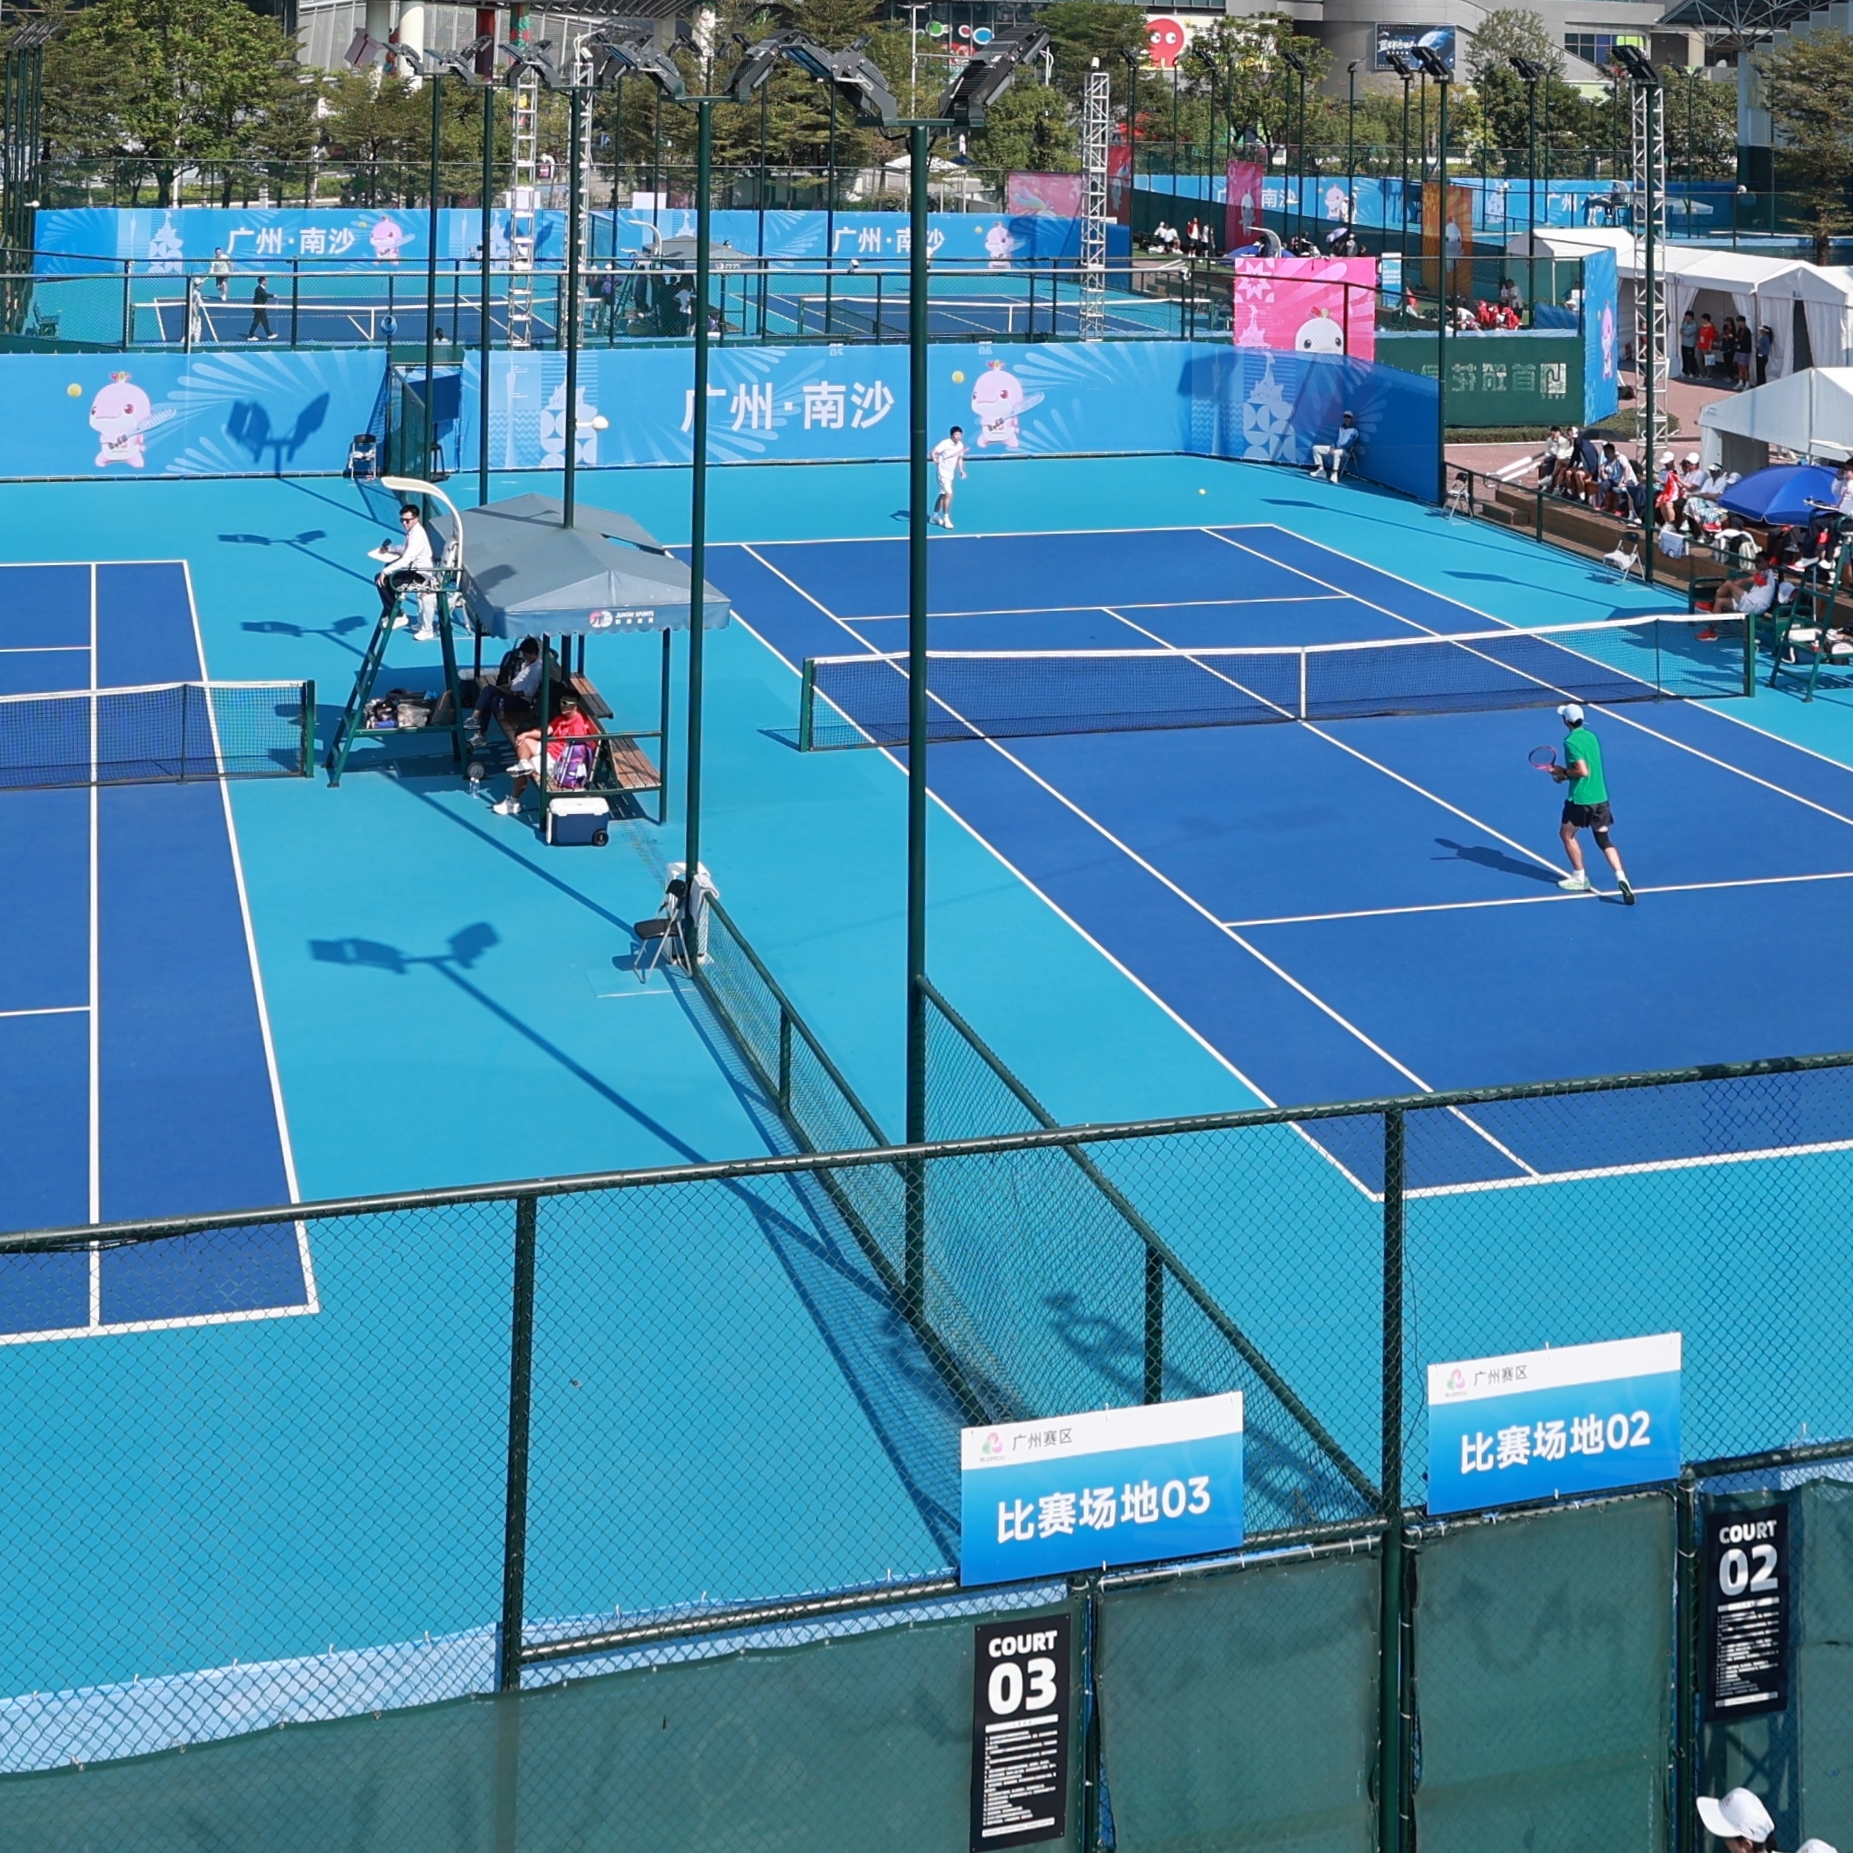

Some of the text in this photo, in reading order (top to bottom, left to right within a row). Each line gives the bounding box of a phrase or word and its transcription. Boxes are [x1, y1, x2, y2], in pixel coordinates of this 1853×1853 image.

[227, 226, 355, 255] 广州·南沙
[680, 380, 895, 434] 广州·南沙
[1474, 1365, 1528, 1388] 广州赛区
[1012, 1427, 1073, 1451] 广州赛区
[1460, 1410, 1652, 1475] 比赛场地02
[997, 1475, 1212, 1545] 比赛场地03
[1719, 1520, 1777, 1544] COURT
[1719, 1544, 1779, 1596] 02
[988, 1630, 1058, 1658] COURT
[988, 1657, 1057, 1715] 03
